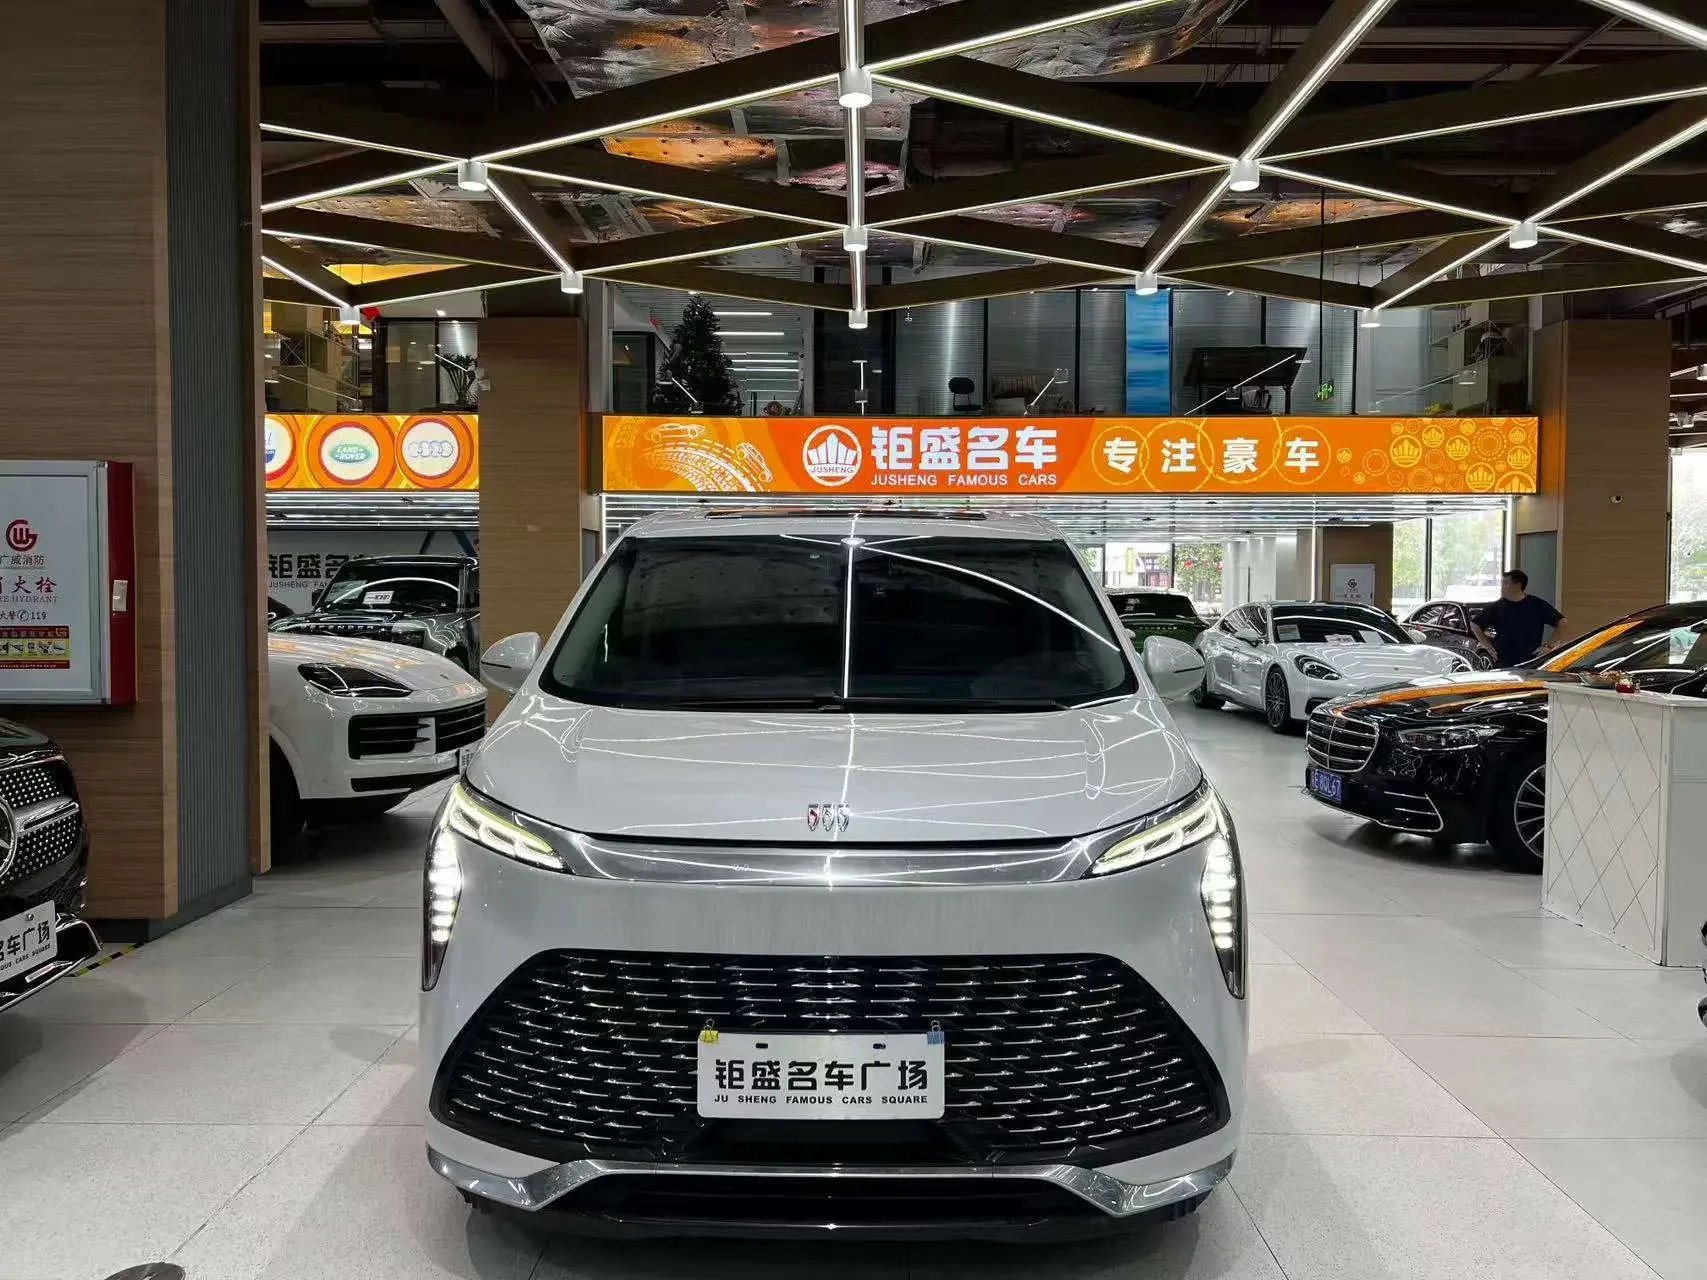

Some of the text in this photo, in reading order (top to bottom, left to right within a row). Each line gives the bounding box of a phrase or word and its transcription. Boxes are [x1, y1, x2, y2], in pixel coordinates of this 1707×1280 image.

[871, 426, 1057, 470] 钜盛名车
[1103, 437, 1320, 474] 专注豪车
[811, 466, 854, 474] JUSHENG
[871, 474, 1057, 486] JUSHENG FAMOUS CARS
[31, 611, 47, 620] 119
[715, 1059, 928, 1090] 钜盛名车广场
[714, 1094, 928, 1104] JU SHENG FAMOUS CARS SQUARE
